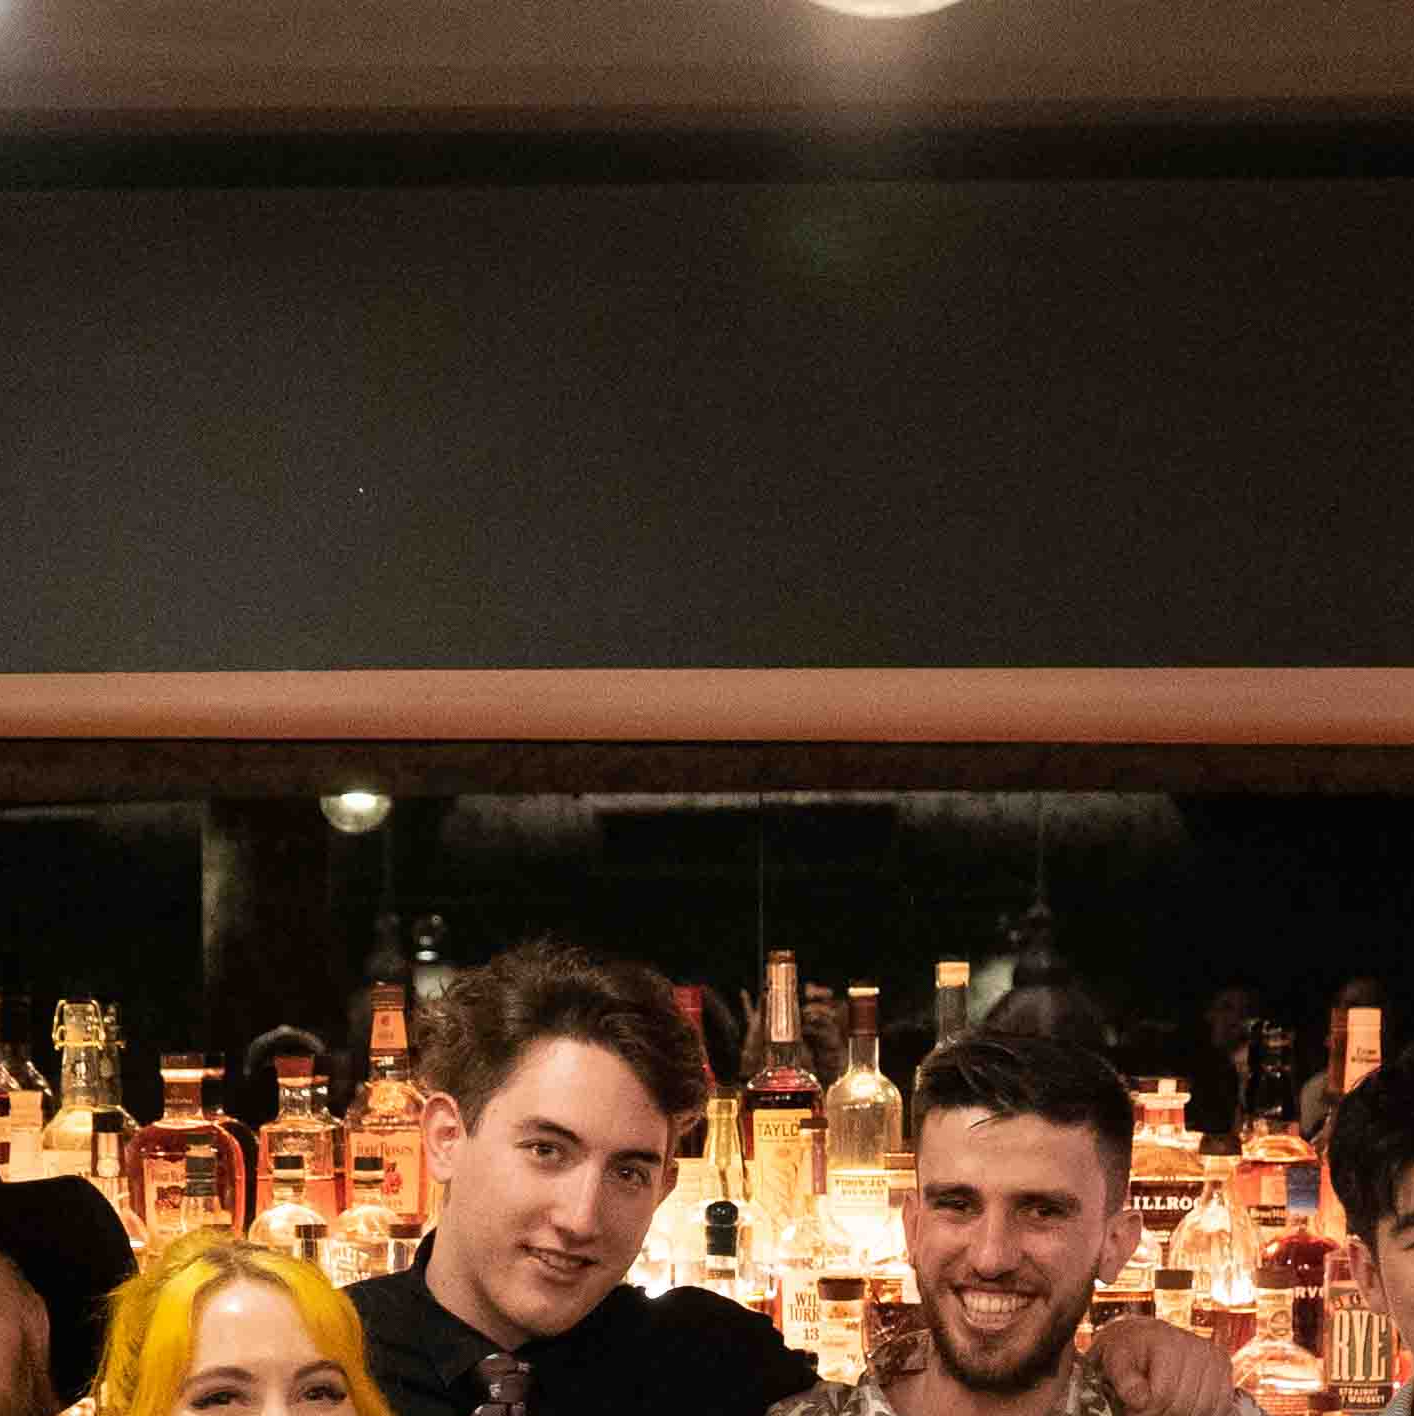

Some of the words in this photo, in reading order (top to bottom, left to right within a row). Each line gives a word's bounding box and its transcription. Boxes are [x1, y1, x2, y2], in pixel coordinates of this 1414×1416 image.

[757, 1123, 800, 1137] TAYLO
[1133, 1195, 1204, 1211] ILLRO
[795, 1292, 818, 1307] WIL
[788, 1303, 820, 1322] TURK
[1330, 1310, 1388, 1381] RYE
